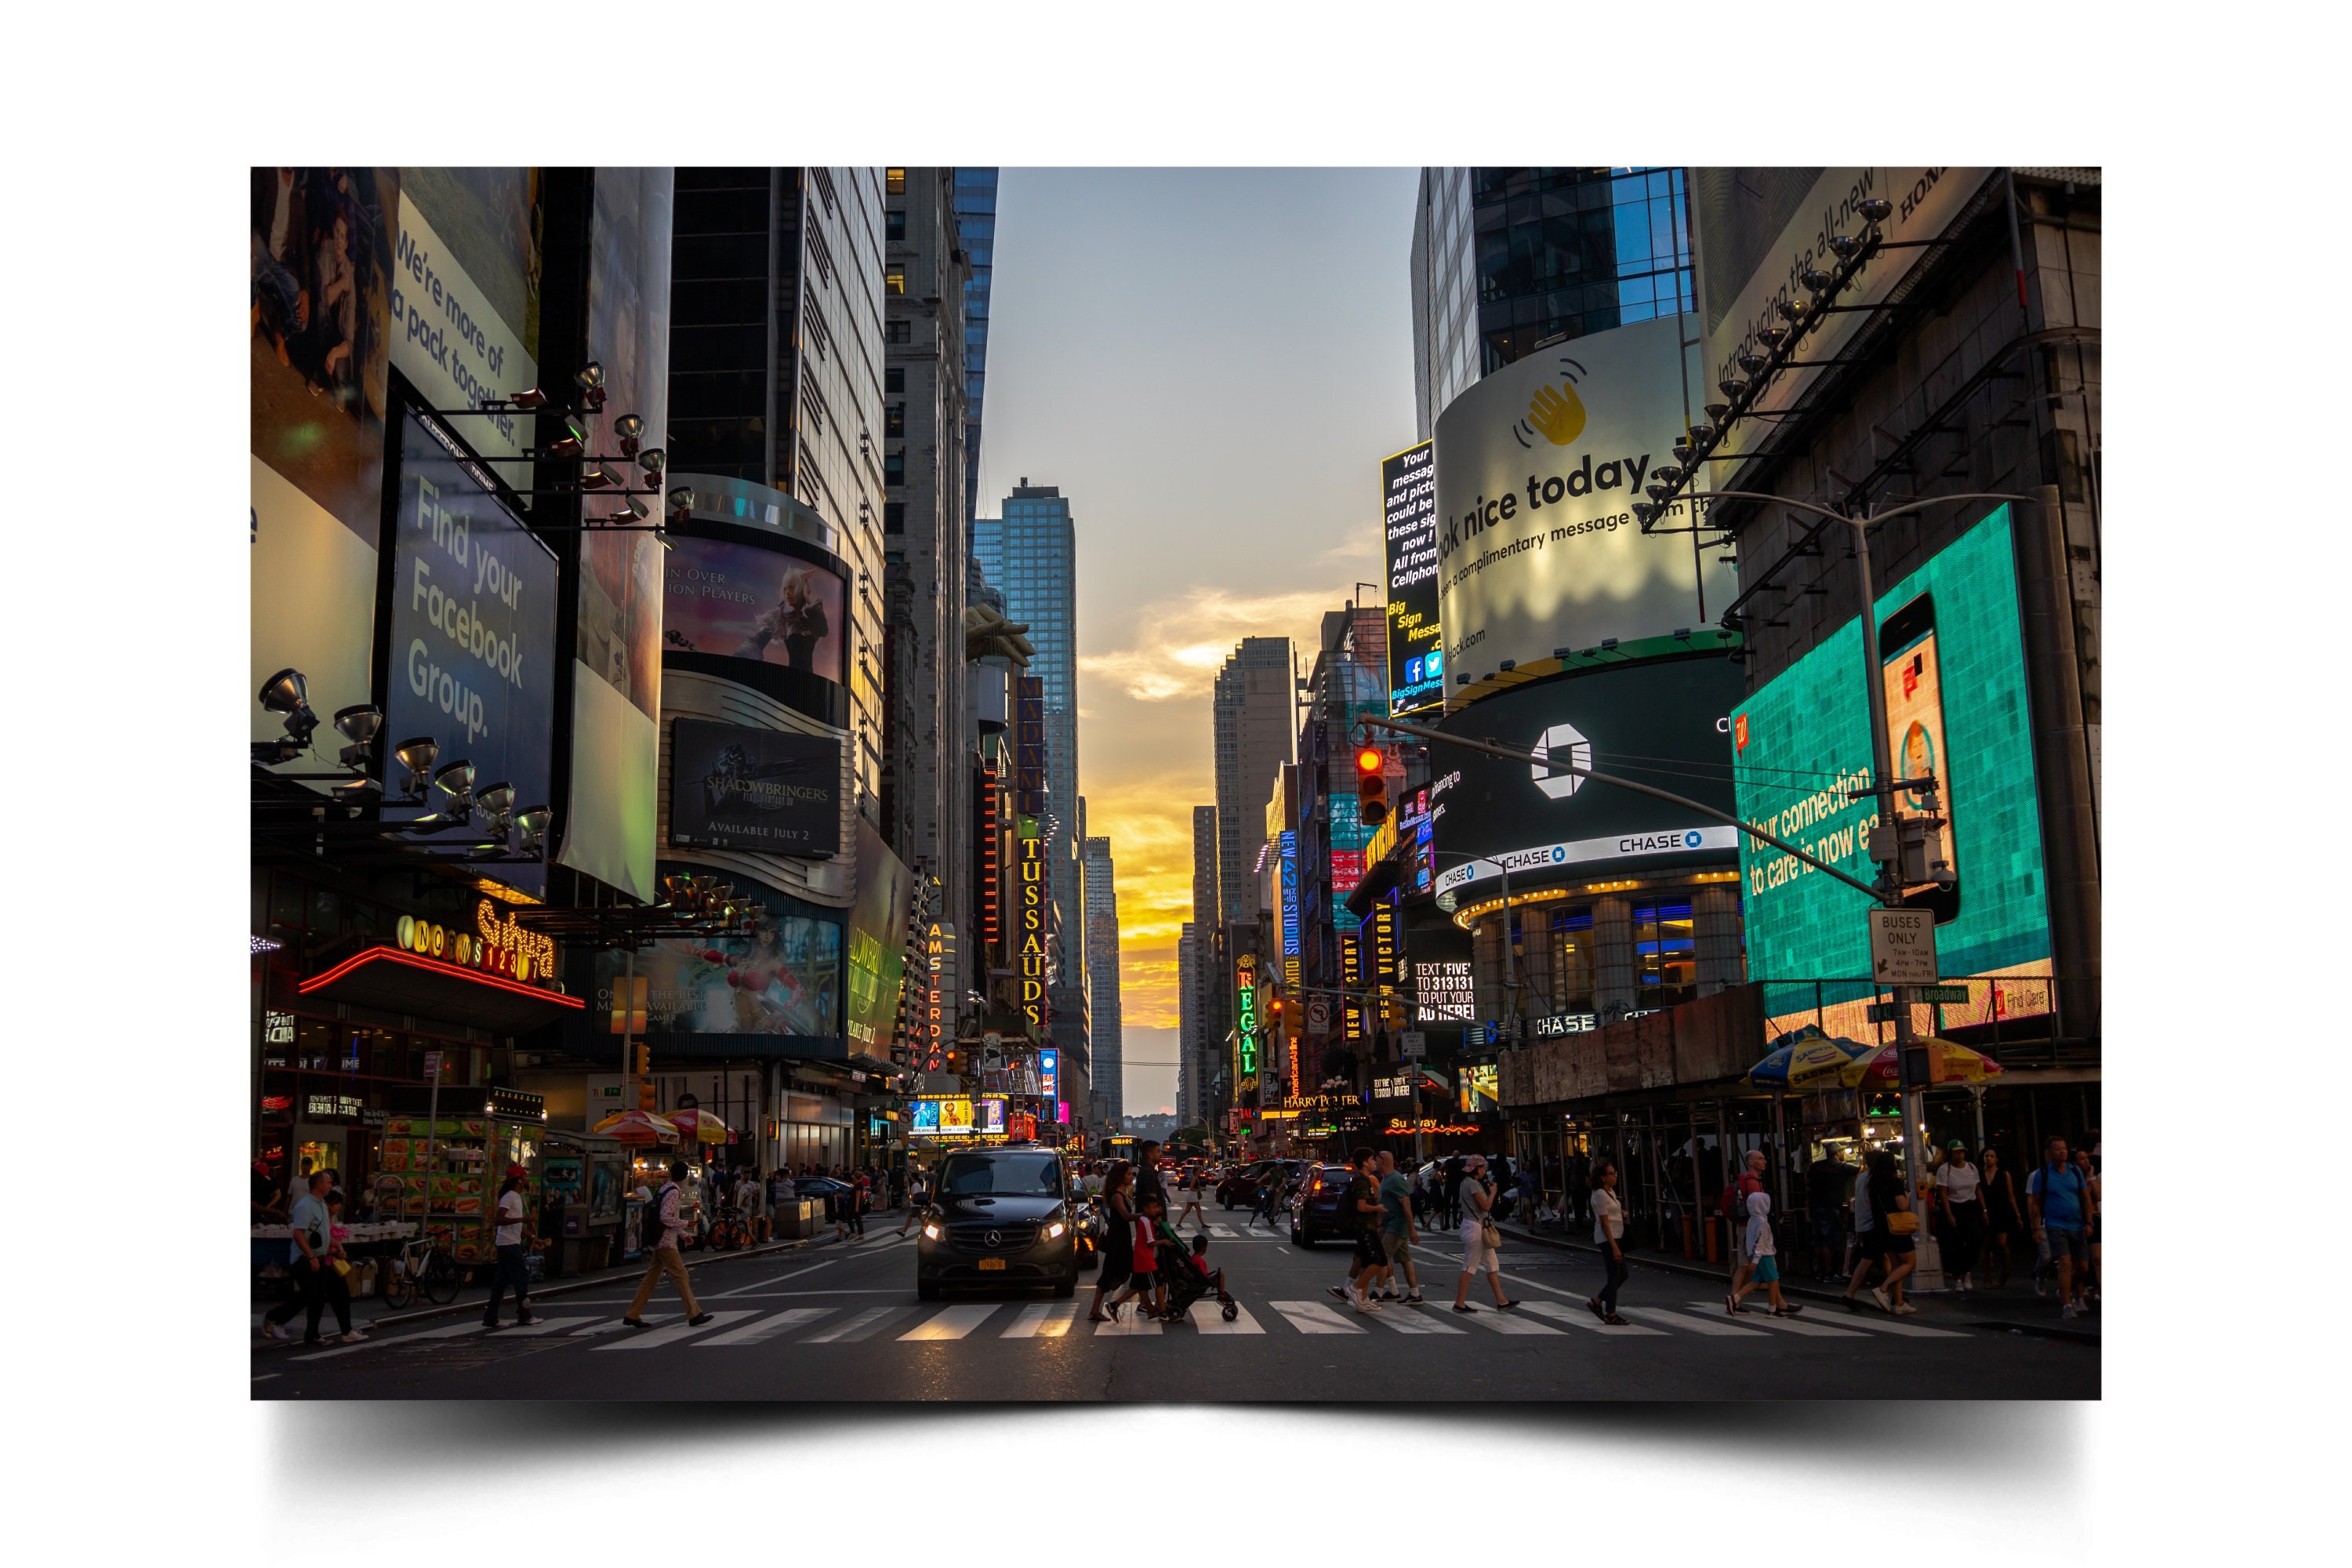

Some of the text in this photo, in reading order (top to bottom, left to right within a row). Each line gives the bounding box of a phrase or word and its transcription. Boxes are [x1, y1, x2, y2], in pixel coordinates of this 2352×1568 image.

[1719, 167, 1873, 383] Introducing the all-new
[396, 221, 503, 379] We're more of
[392, 288, 514, 447] a pack together.
[1403, 449, 1429, 468] Your
[1386, 489, 1407, 508] and
[1464, 453, 1659, 541] nice today.
[1387, 498, 1433, 524] could be
[1388, 521, 1417, 541] these
[417, 474, 522, 612] Find your
[1402, 534, 1427, 551] now
[1453, 575, 1457, 586] a
[1458, 529, 1545, 580] complimentary
[1550, 513, 1630, 545] message
[1392, 547, 1437, 572] All from
[687, 568, 725, 584] OVER
[702, 585, 756, 605] PLAYERS
[1388, 601, 1406, 615] Big
[412, 556, 522, 689] Facebook
[1397, 612, 1422, 629] Sign
[1448, 629, 1486, 664] slack.com
[408, 638, 488, 744] Group.
[1454, 770, 1461, 782] to
[707, 776, 828, 801] SHADOWBRINGERS
[1747, 767, 1870, 854] Your connection
[709, 822, 810, 840] AVAILABLE JULY 2
[1281, 832, 1296, 857] NEW
[1619, 833, 1682, 853] CHASE
[1506, 850, 1550, 869] CHASE
[1751, 864, 1764, 896] to
[1767, 852, 1798, 890] care
[1818, 825, 1853, 866] now
[1445, 867, 1466, 887] CHASE
[1283, 904, 1299, 955] STUDIOS
[1882, 916, 1921, 928] BUSES
[1376, 902, 1392, 975] VICTORY
[1888, 932, 1918, 945] ONLY
[1415, 964, 1440, 975] TEXT
[1416, 975, 1473, 991] TO 313131
[652, 990, 704, 1000] THE BEST
[1417, 991, 1474, 1004] TO PUT YOUR
[1925, 985, 1967, 1004] Broadway
[2007, 989, 2045, 1009] Find Care
[645, 1002, 706, 1011] AVAILABLE
[1418, 1004, 1475, 1021] AD HERE!
[1875, 1005, 1892, 1017] W 42
[1238, 971, 1256, 1073] REGAL
[1346, 1008, 1360, 1039] NEW
[1537, 1015, 1596, 1035] CHASE
[1283, 1095, 1319, 1109] HARRY
[930, 1102, 938, 1126] FROZEN
